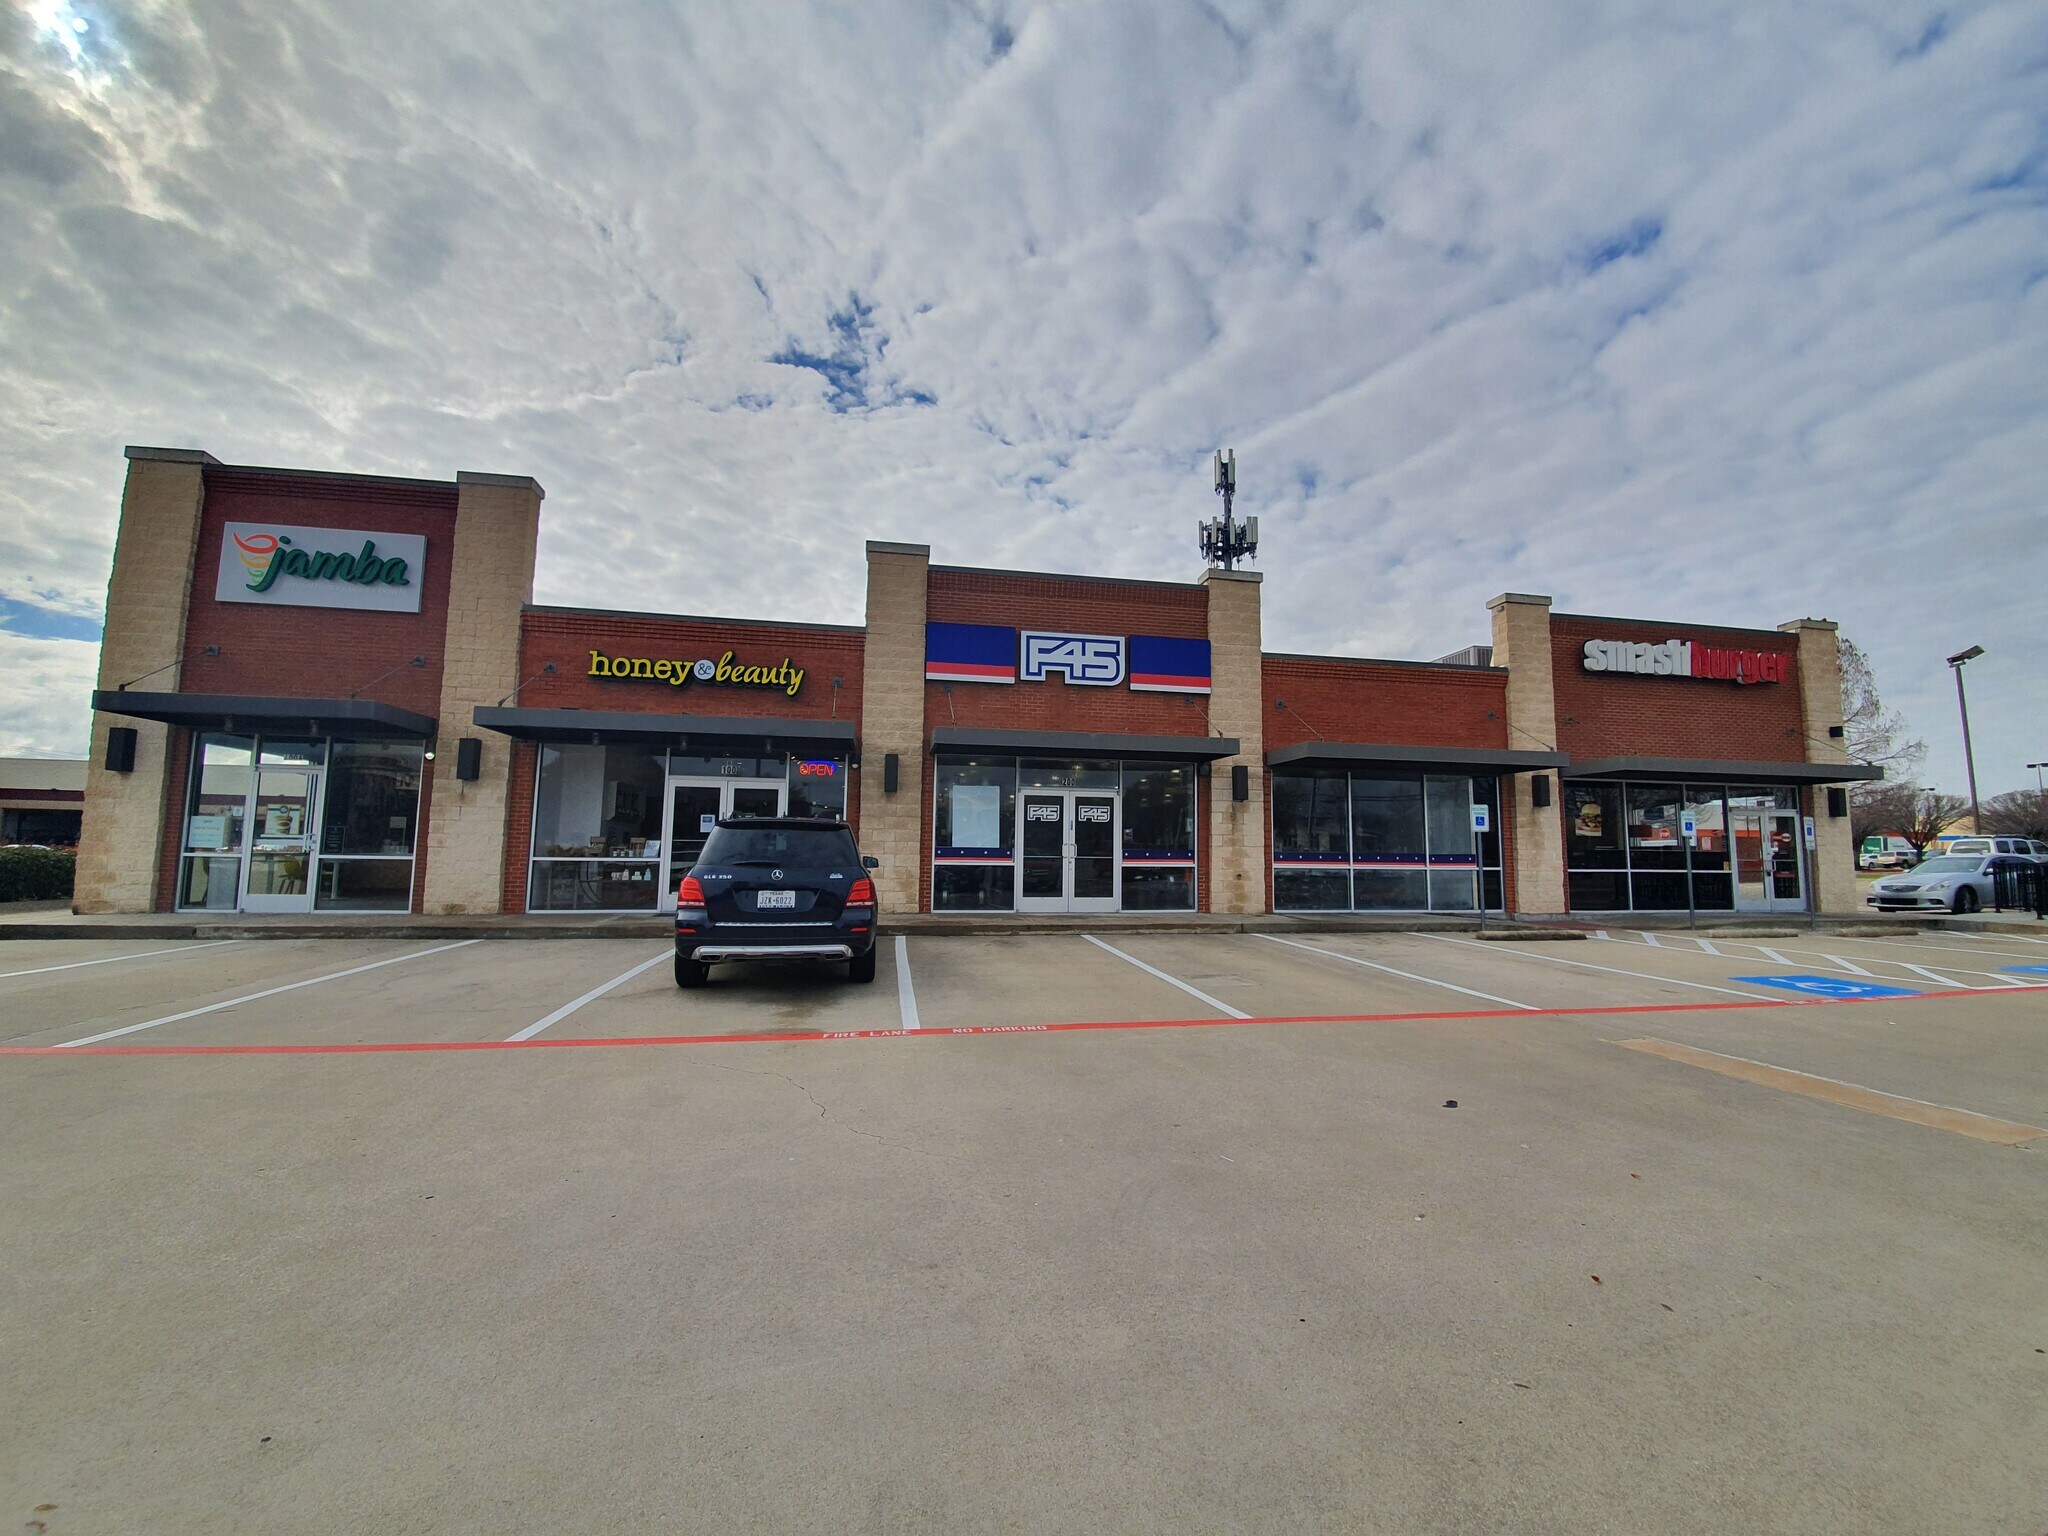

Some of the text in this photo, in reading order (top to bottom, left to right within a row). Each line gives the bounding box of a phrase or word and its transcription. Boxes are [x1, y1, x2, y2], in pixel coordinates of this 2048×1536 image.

[246, 535, 410, 593] jamba
[1026, 634, 1121, 683] F45
[588, 650, 804, 695] honey & beauty
[721, 764, 738, 775] 100
[800, 763, 834, 776] OPEN
[1062, 778, 1076, 786] 200
[1028, 805, 1060, 821] F45
[1079, 806, 1110, 822] F45
[823, 1031, 860, 1039] FIRE
[870, 1029, 912, 1037] LANE
